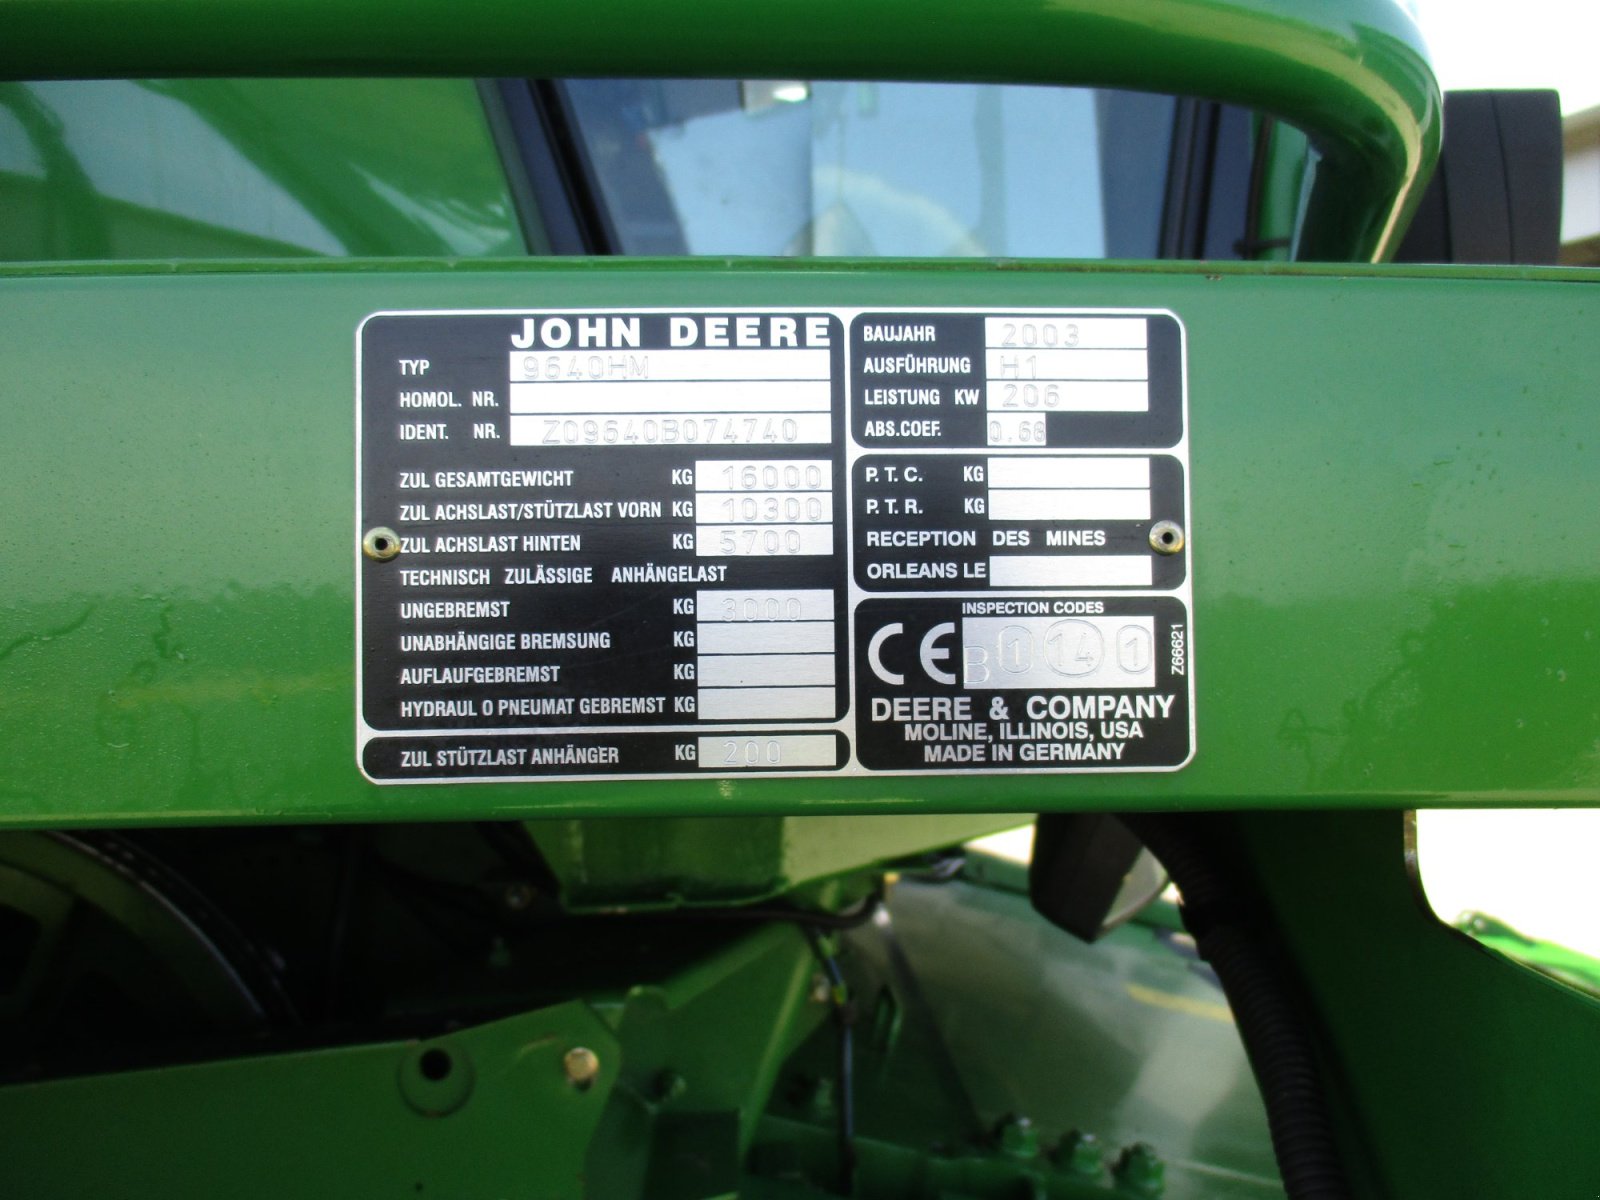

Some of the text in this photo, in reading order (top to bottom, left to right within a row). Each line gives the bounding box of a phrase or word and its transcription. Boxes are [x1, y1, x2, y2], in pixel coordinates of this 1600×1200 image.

[511, 317, 831, 348] JOHN DEERE
[863, 324, 1080, 347] BAUJAHR 2003
[399, 355, 650, 381] TYP 9640HM
[863, 354, 1038, 379] AUSFÜHRUNG H1
[399, 391, 499, 408] HOMOL. NR.
[864, 384, 1061, 408] LEISTUNG KW 206
[399, 424, 448, 440] IDENT.
[473, 424, 500, 439] NR.
[865, 421, 941, 437] ABS.COEF.
[399, 465, 823, 490] ZUL GESAMTGEWICHT KG 16000
[963, 466, 984, 482] KG
[400, 498, 823, 523] ZUL ACHSLAST/STÜTZLAST VORN KG 10300
[964, 498, 985, 514] KG
[400, 529, 801, 554] ZUL ACHSLAST HINTEN KG 5700
[866, 531, 1105, 546] RECEPTION DES MINES
[400, 563, 726, 586] TECHNISCH ZULÄSSIGE ANHÄNGELAST
[867, 563, 986, 579] ORLEANS LE
[401, 597, 801, 622] UNGEBREMST KG 3000
[962, 601, 1104, 614] INSPECTION CODES
[401, 631, 694, 652] UNABHÄNGIGE BREMSUNG KG
[1171, 624, 1184, 675] Z66621
[401, 664, 695, 685] AUFLAUFGEBREMST KG
[401, 700, 477, 718] HYDRAUL
[498, 699, 575, 716] PNEUMAT
[579, 697, 666, 714] GEBREMST
[674, 697, 695, 713] KG
[872, 695, 1175, 721] DEERE & COMPANY
[904, 722, 1143, 743] MOLINE, ILLINOIS, USA
[401, 739, 783, 767] ZUL STÜTZLAST ANHÄNGER KG 200
[924, 743, 1125, 762] MADE IN GERMANY
